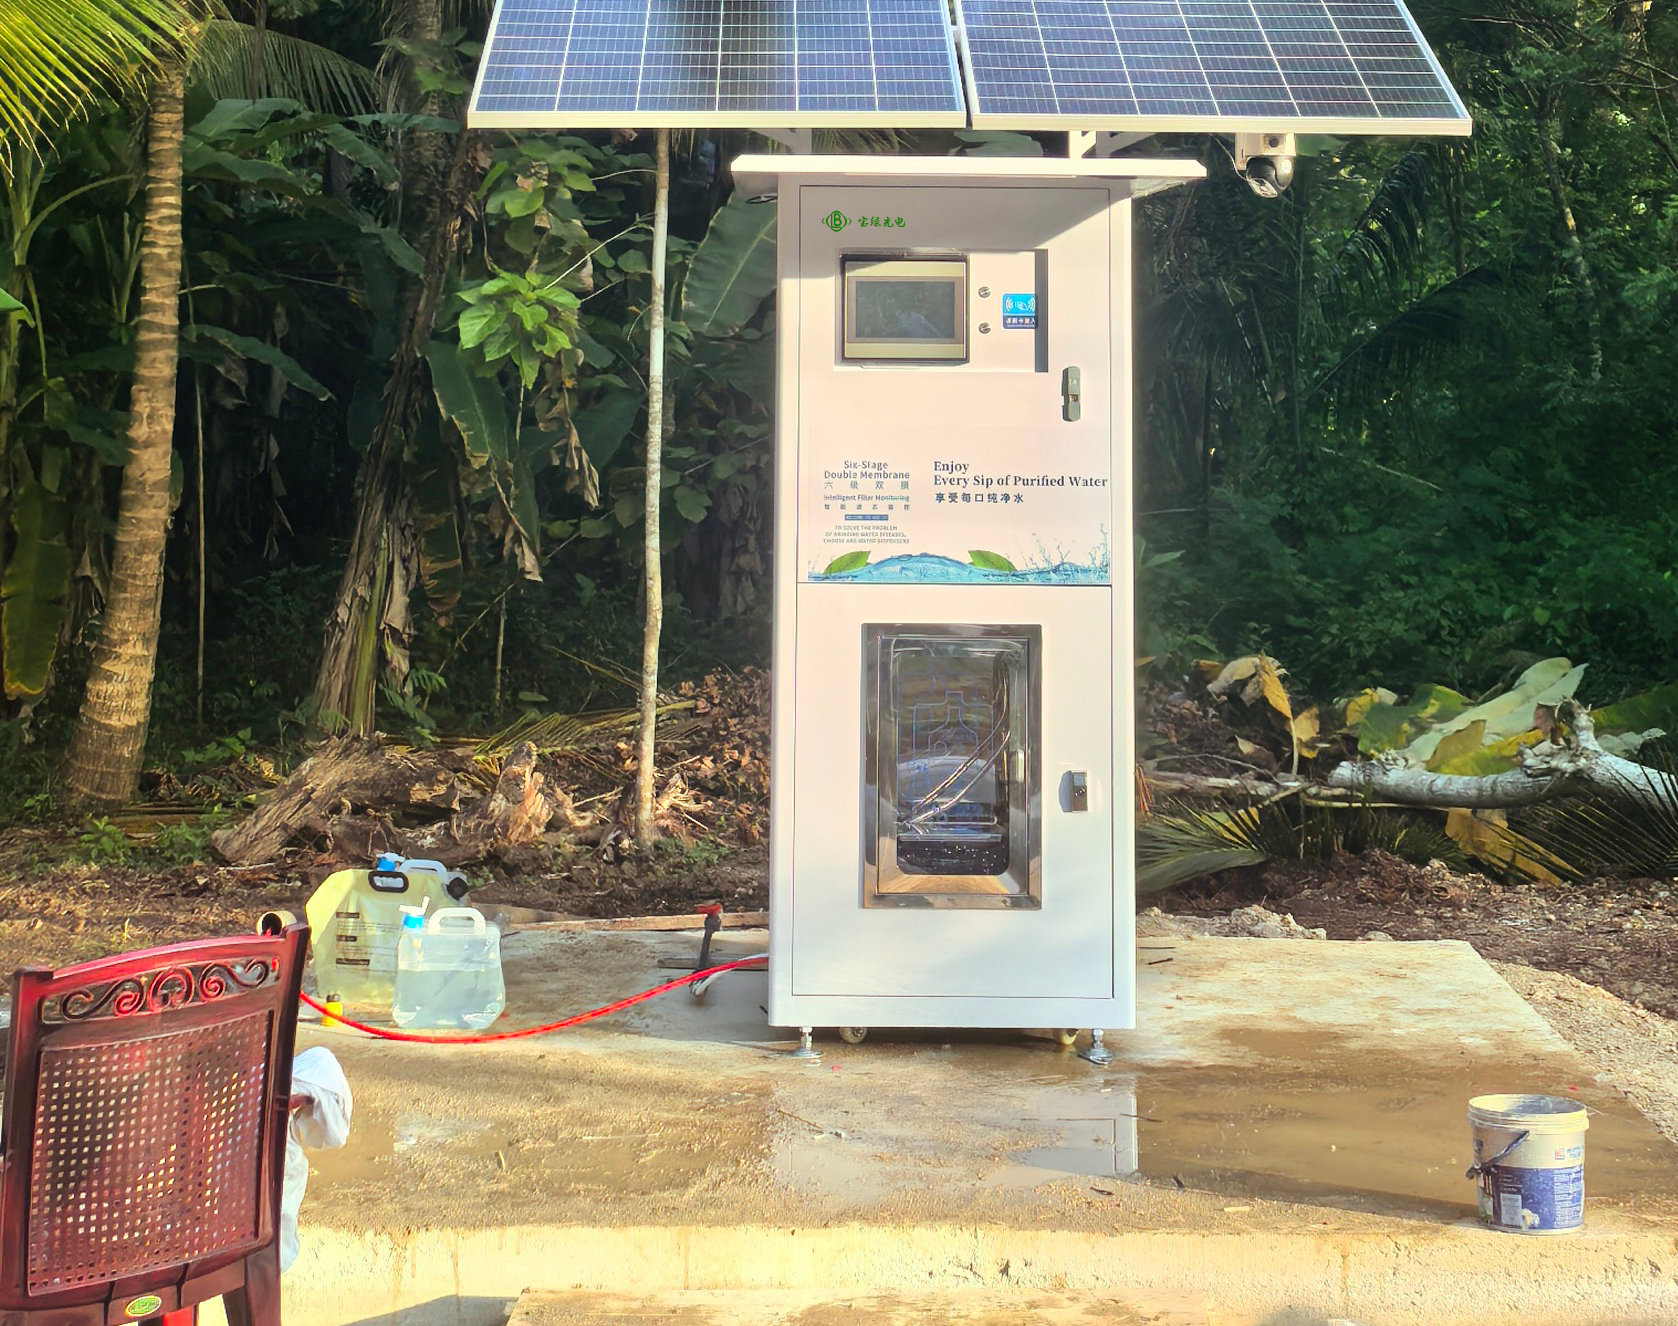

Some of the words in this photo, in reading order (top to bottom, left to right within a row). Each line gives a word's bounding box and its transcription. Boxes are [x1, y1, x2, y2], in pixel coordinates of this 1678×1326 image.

[843, 460, 888, 471] Six-Stage
[933, 460, 970, 474] Enjoy
[824, 470, 858, 479] Double
[859, 470, 910, 479] Membrane
[933, 474, 970, 488] Every
[973, 474, 994, 489] Sip
[996, 474, 1011, 486] of
[1013, 475, 1065, 487] Purified
[1068, 476, 1108, 487] Water
[823, 494, 856, 502] Intelligent
[934, 492, 1024, 504] 享受每口纯净水
